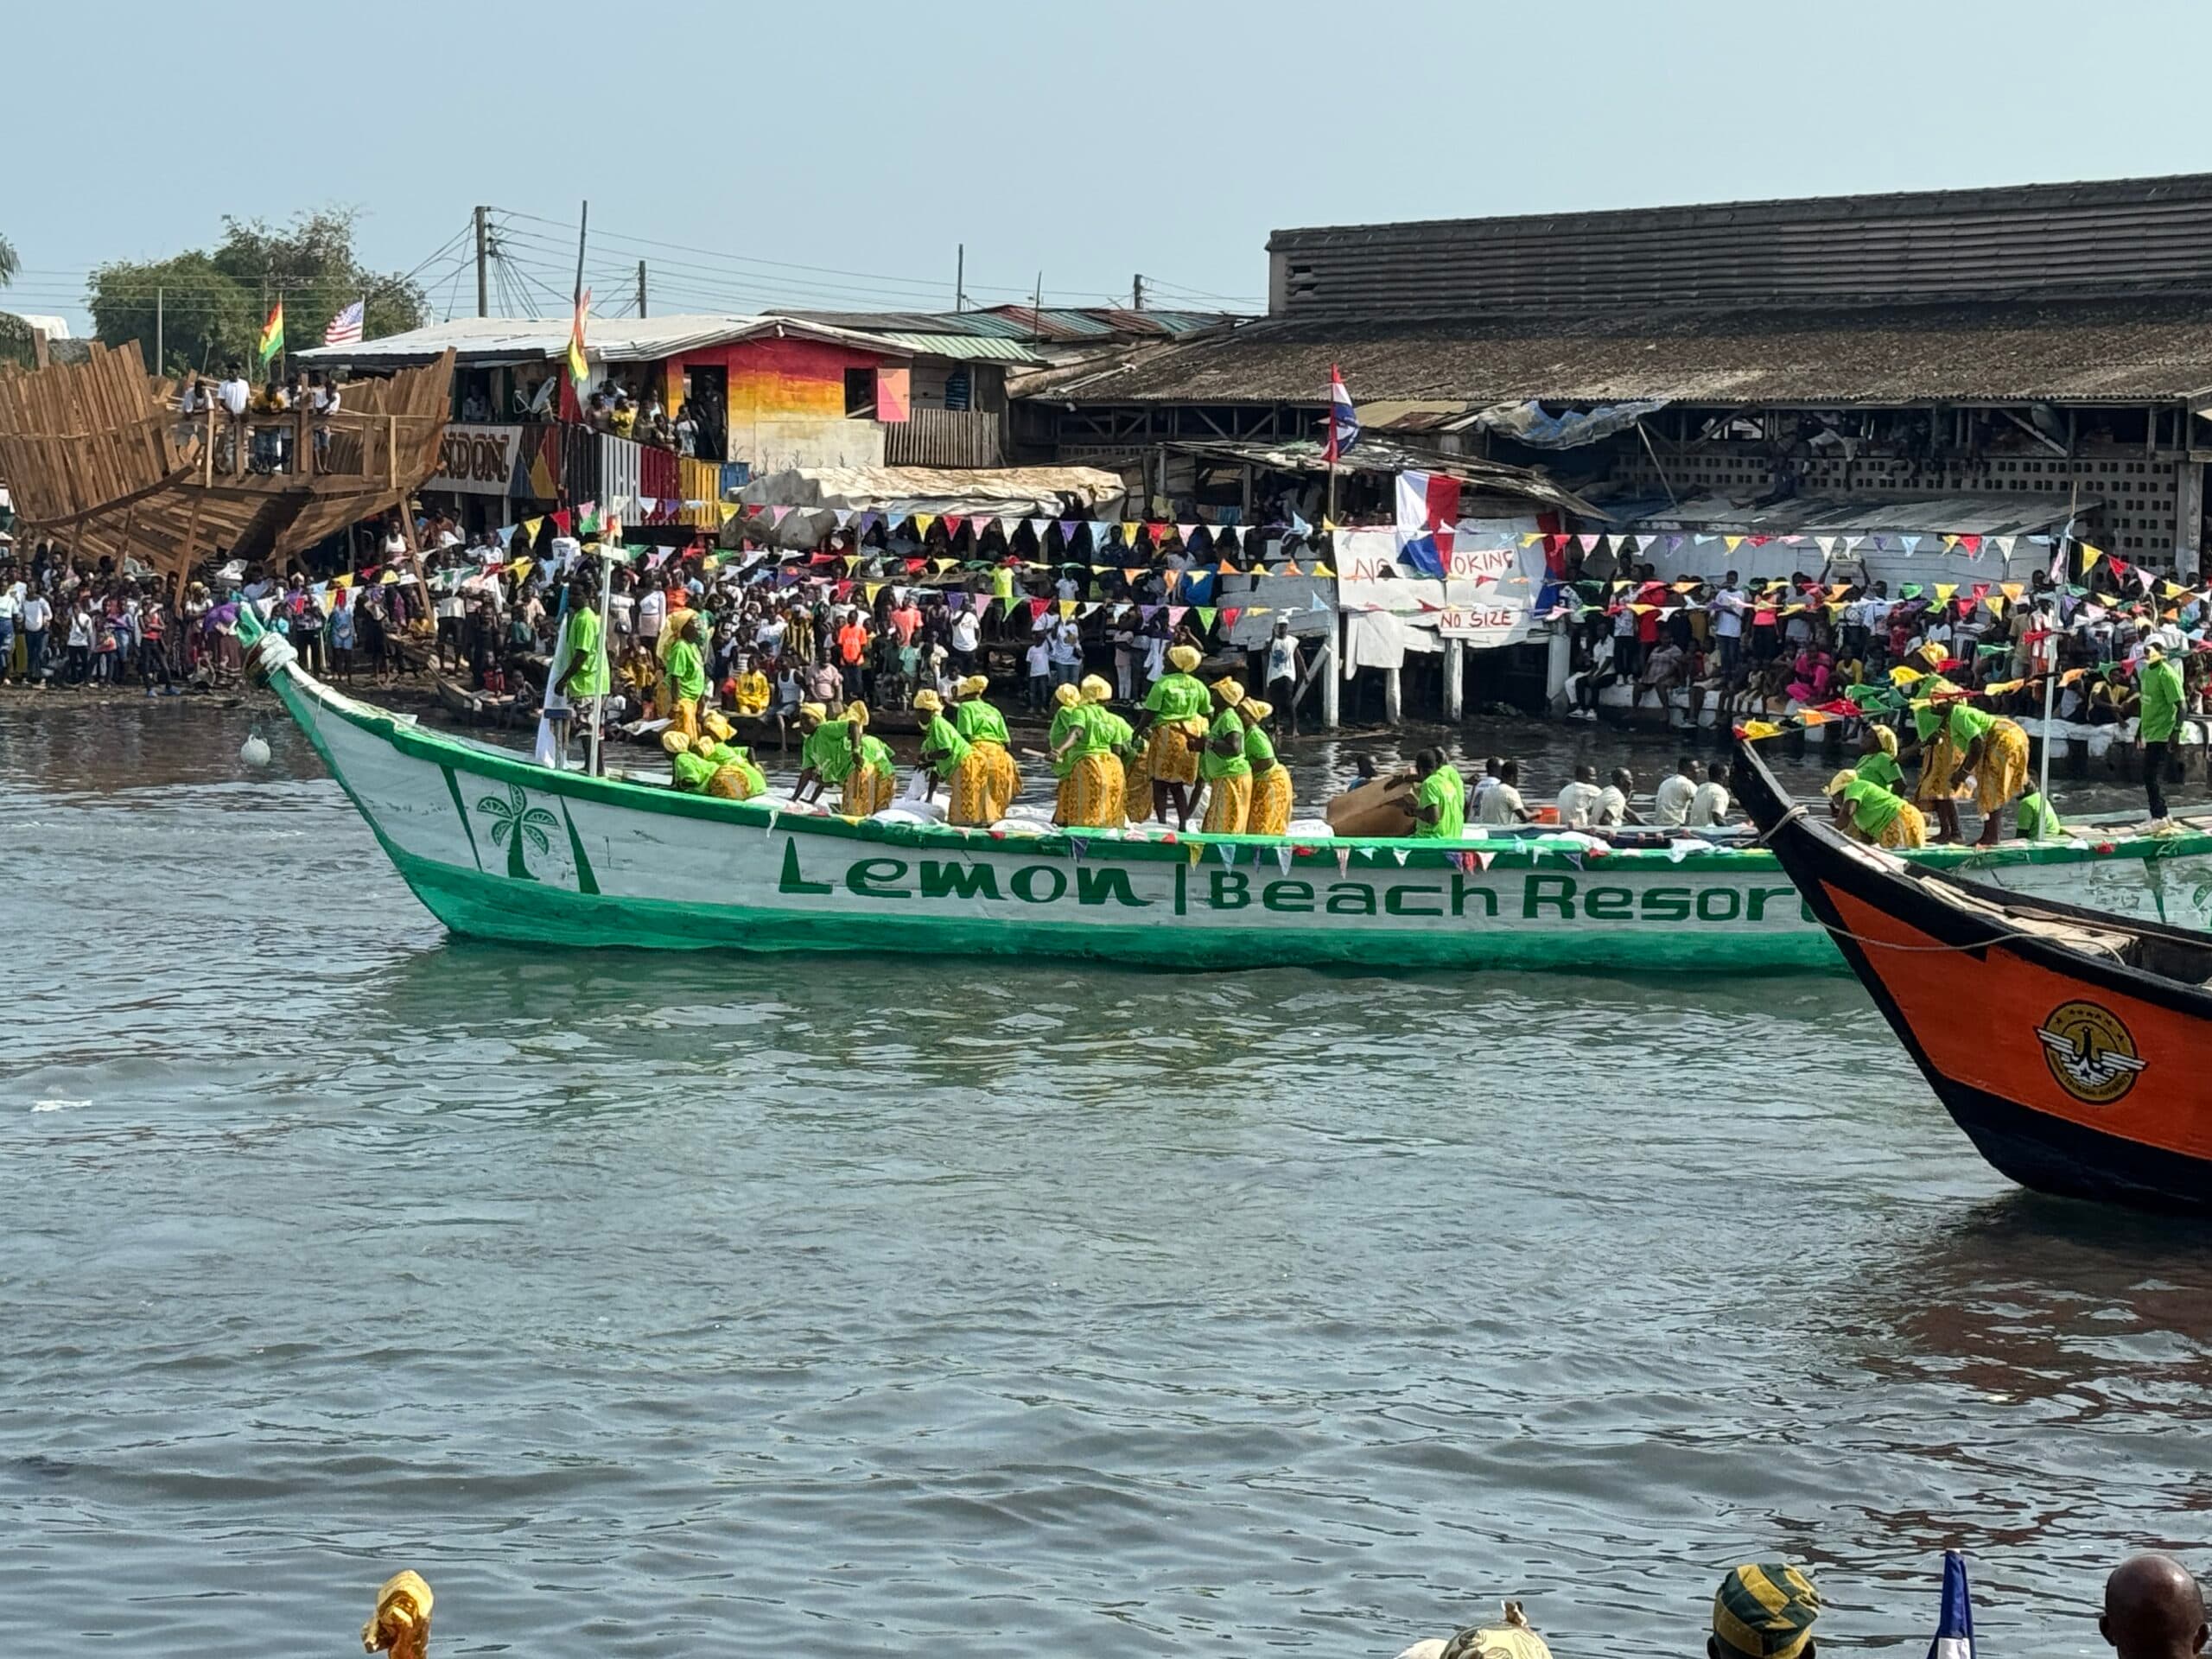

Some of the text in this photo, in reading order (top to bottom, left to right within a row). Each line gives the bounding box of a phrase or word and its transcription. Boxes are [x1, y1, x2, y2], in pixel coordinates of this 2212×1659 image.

[439, 431, 509, 482] NDON
[1453, 550, 1513, 575] OKING
[1440, 610, 1513, 628] NO SIZE
[779, 836, 1155, 906] Lemon
[1211, 870, 1498, 918] Beach
